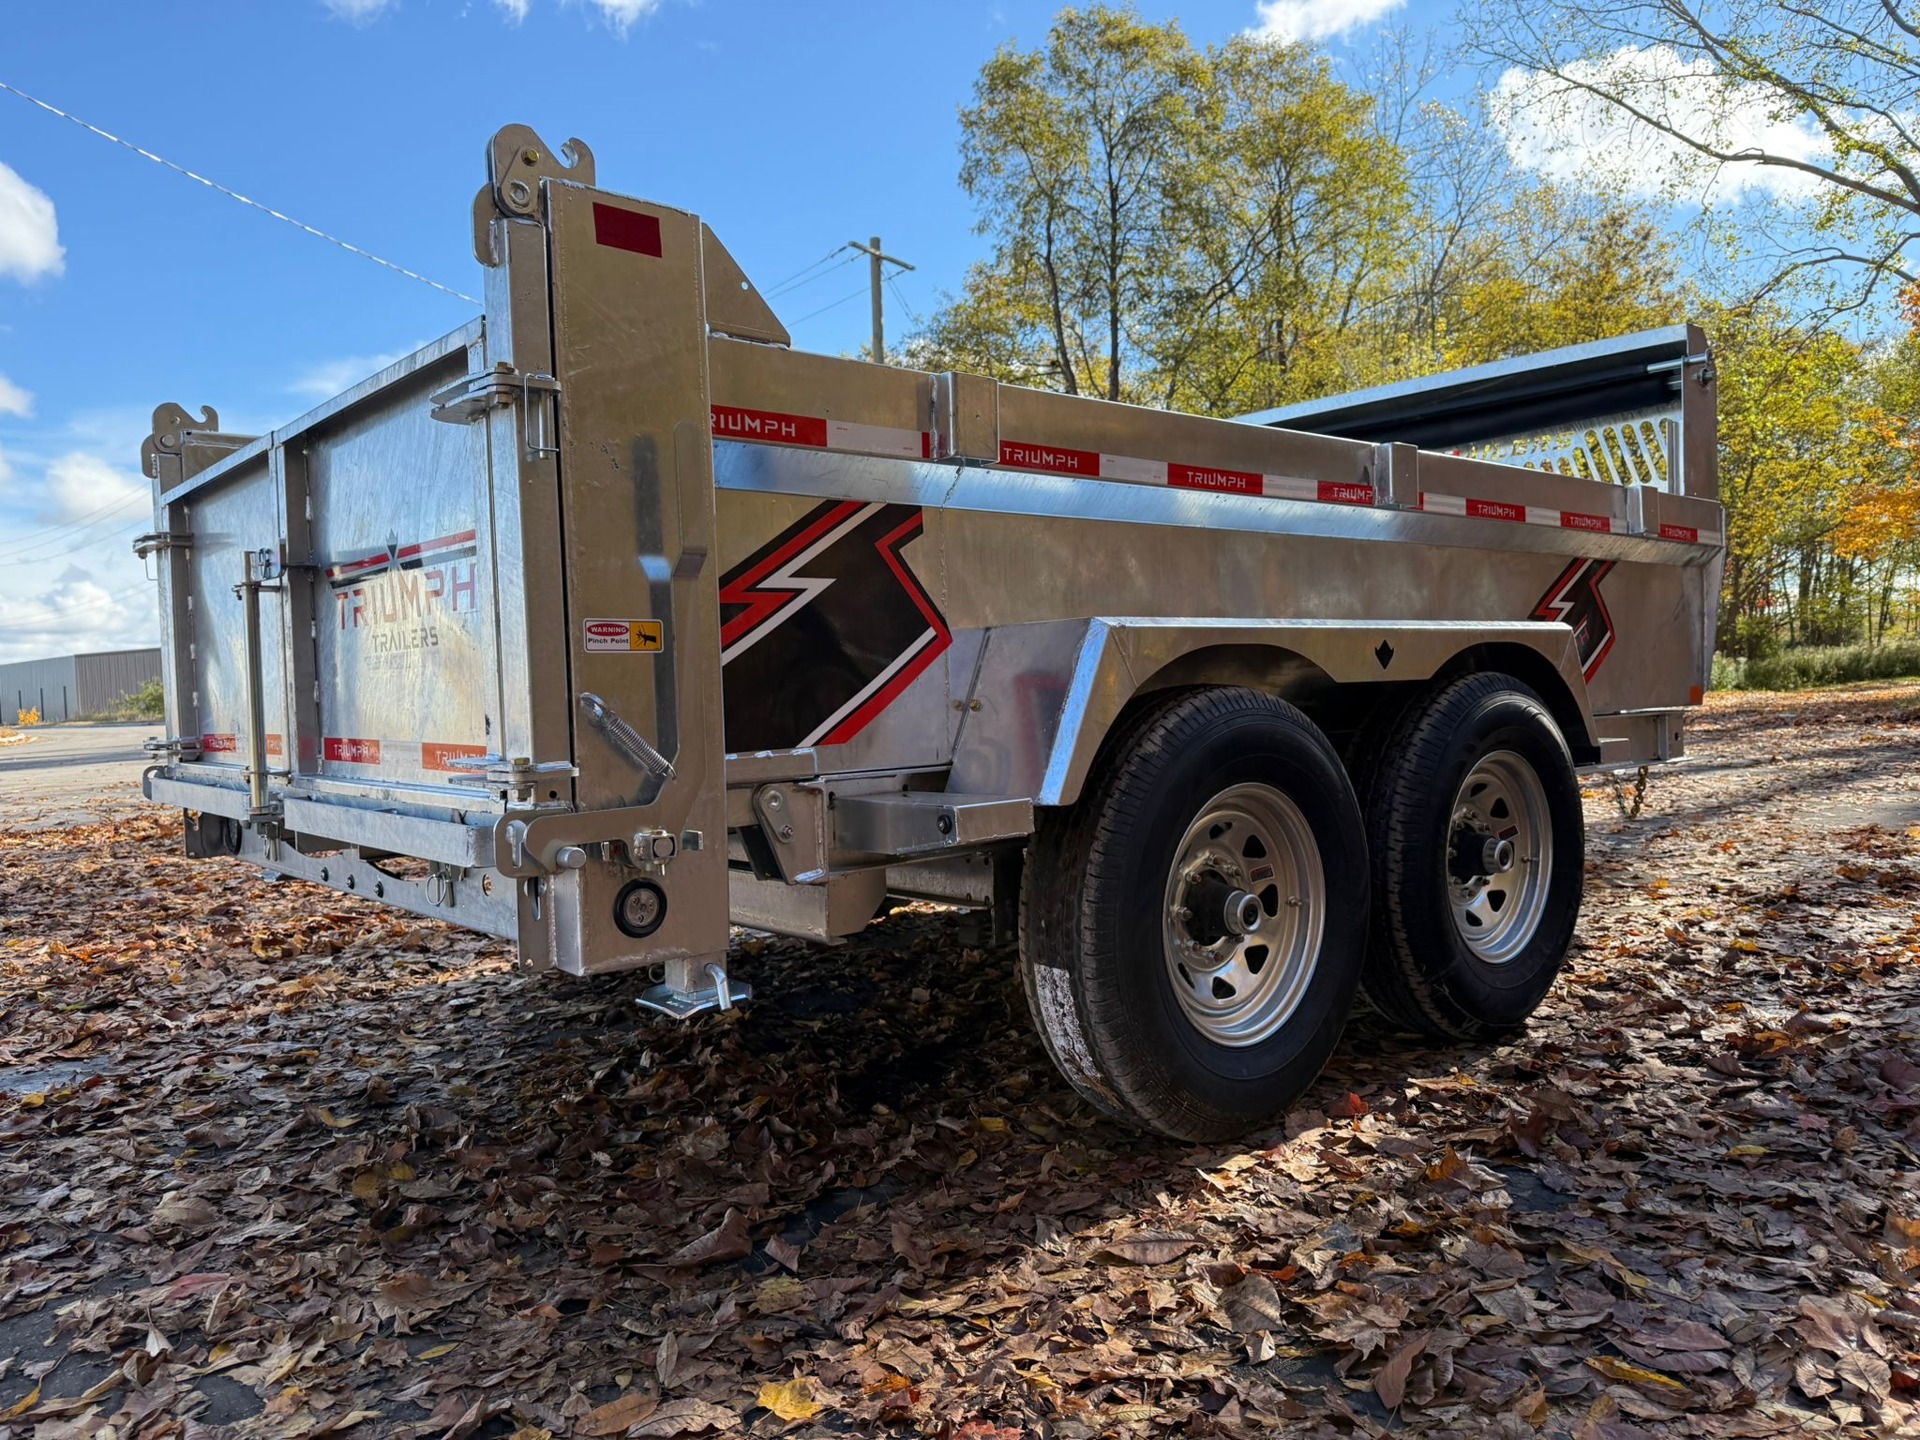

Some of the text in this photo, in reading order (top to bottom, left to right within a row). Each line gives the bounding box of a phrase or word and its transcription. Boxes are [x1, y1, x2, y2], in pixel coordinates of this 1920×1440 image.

[711, 412, 796, 437] RIUMPH
[1002, 447, 1078, 468] TRIUMPH
[1186, 471, 1246, 488] TRIUMPH
[1333, 487, 1373, 500] TRIUMP
[1477, 504, 1516, 518] TRIUMPH
[1569, 516, 1602, 529] TRIUMPH
[333, 562, 477, 630] TRIUMPH
[590, 626, 627, 634] WARNING
[371, 626, 439, 653] TRAILERS
[587, 637, 630, 645] Pinch Point
